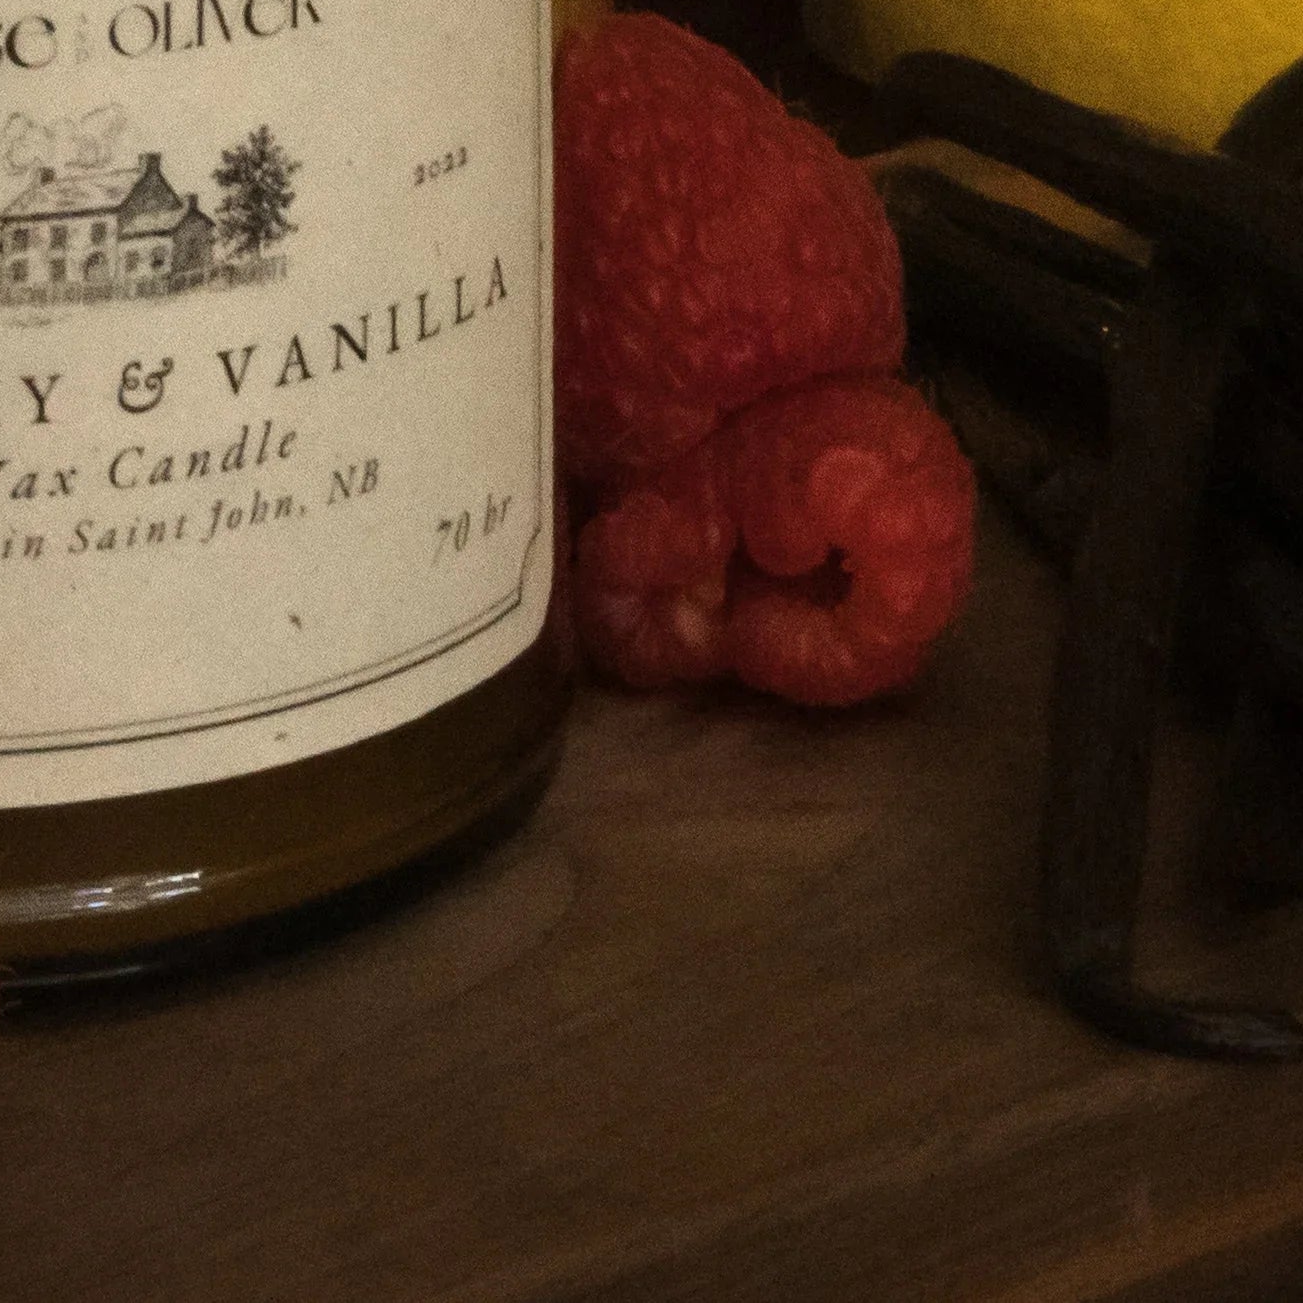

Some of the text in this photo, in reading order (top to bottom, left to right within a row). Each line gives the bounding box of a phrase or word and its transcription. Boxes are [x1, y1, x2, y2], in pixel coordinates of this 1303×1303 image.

[117, 355, 175, 415] &
[215, 255, 508, 396] VANILLA
[107, 419, 297, 491] Candle
[0, 526, 45, 560] in
[66, 512, 188, 555] Saint
[200, 490, 309, 545] John,
[326, 458, 380, 508] NB
[429, 509, 471, 567] 70
